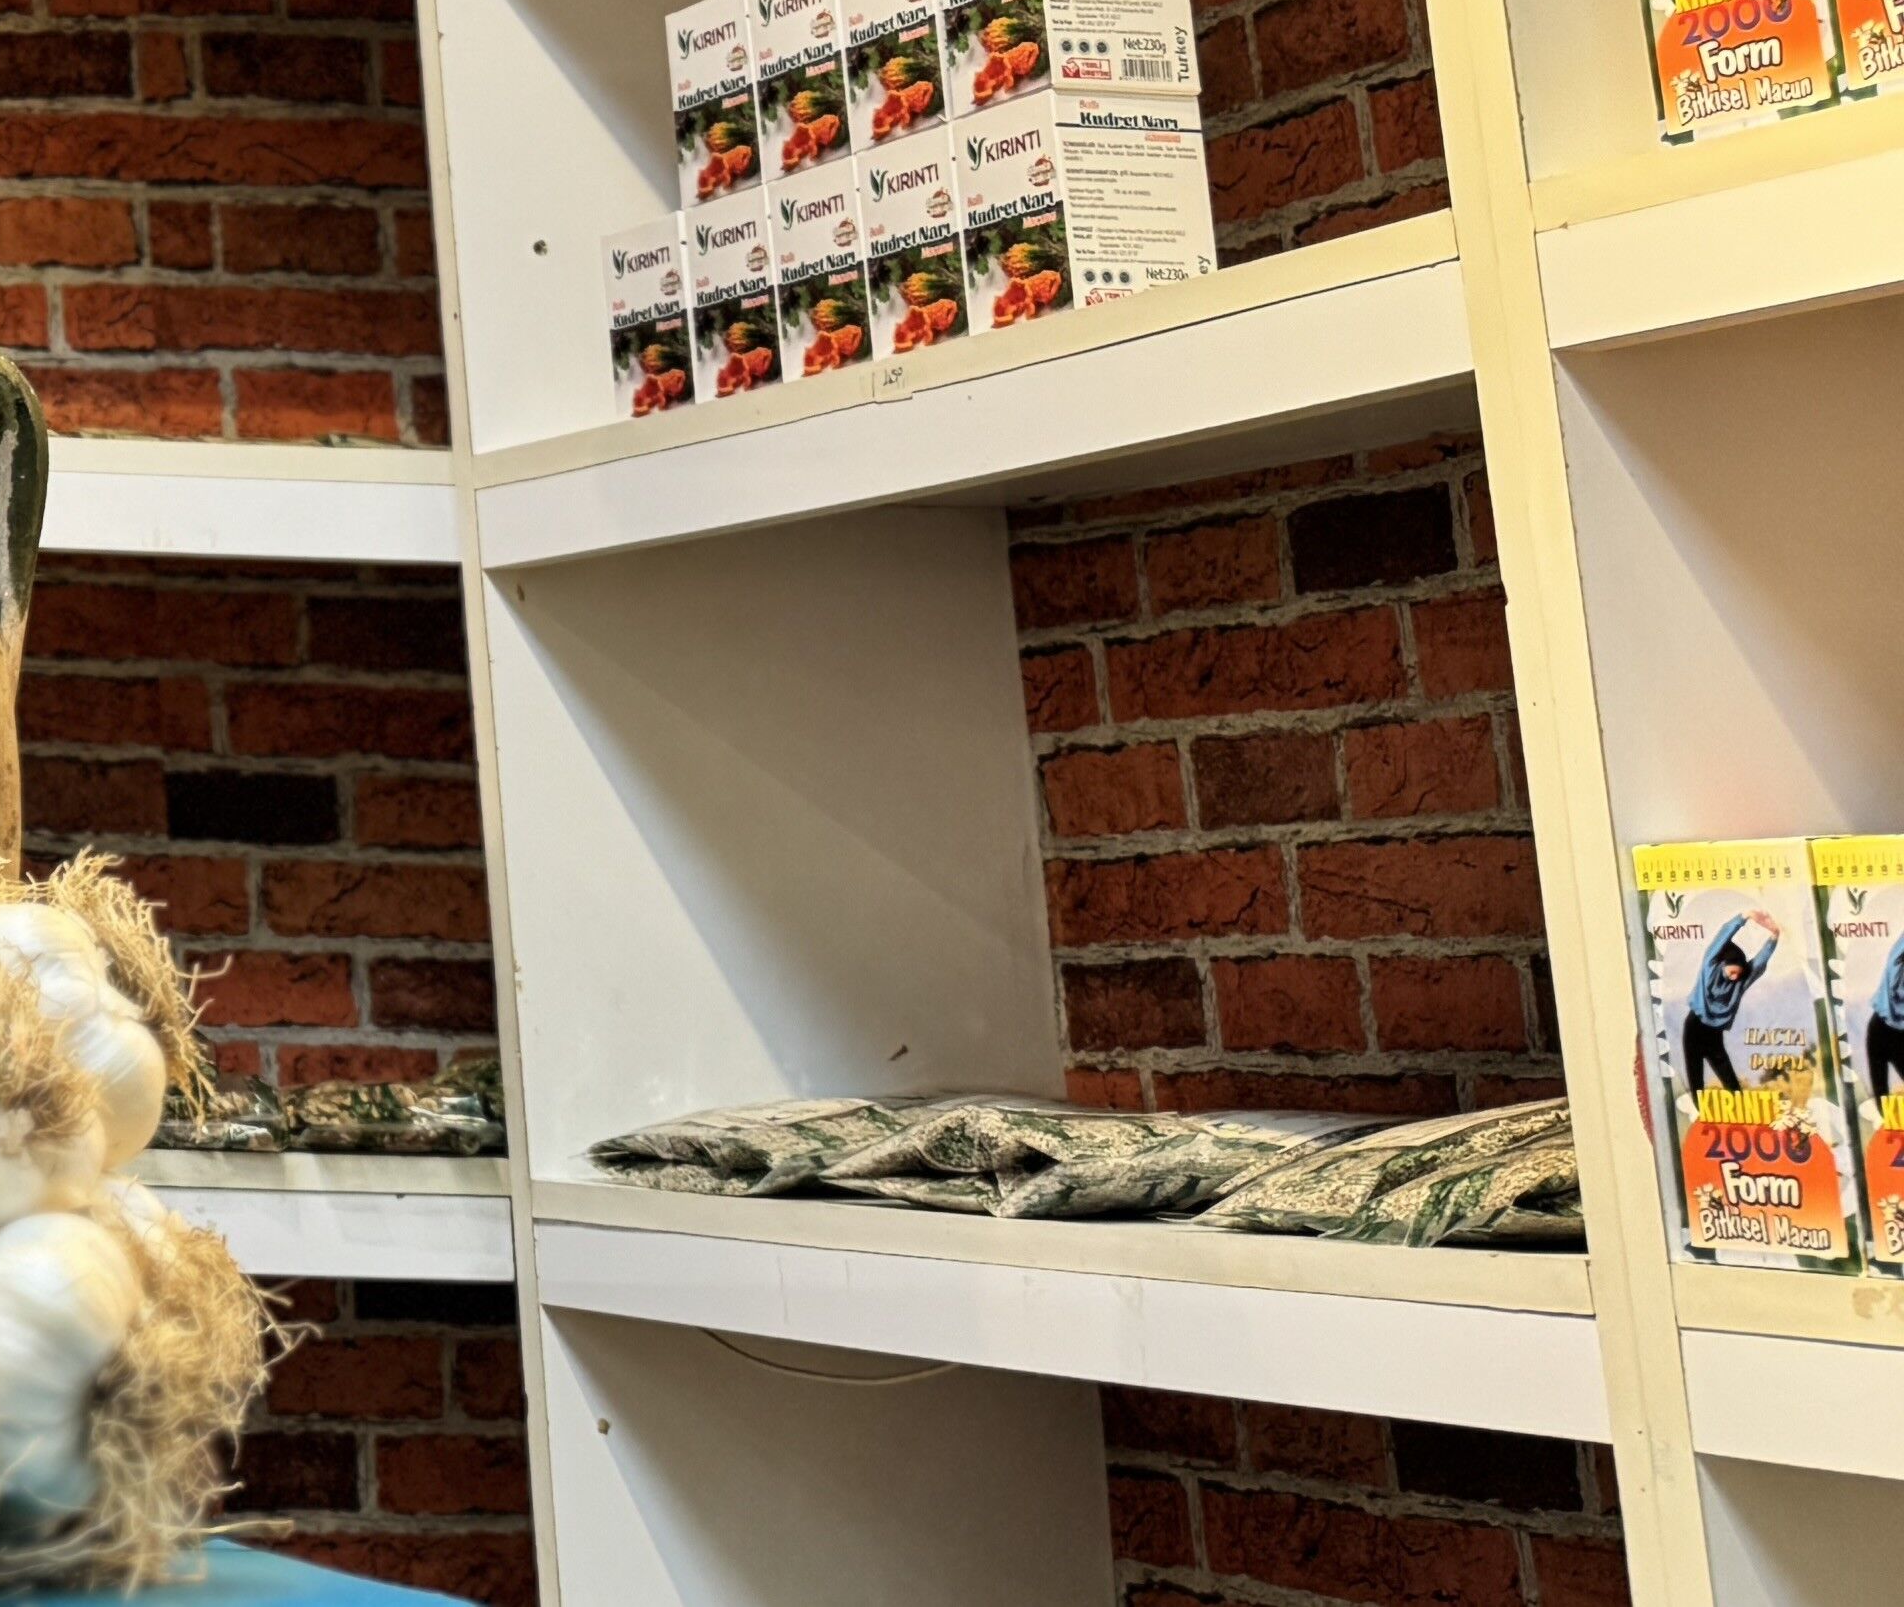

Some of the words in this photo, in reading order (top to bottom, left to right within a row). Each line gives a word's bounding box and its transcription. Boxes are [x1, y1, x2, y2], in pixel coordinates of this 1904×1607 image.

[692, 21, 737, 52] KIRINTI
[850, 17, 894, 45] Kudret
[760, 53, 801, 78] Kudret
[1175, 26, 1188, 83] Turkey
[1698, 36, 1783, 83] Form
[678, 84, 718, 110] Kudret
[1676, 78, 1750, 126] Bitkisel
[1755, 75, 1813, 106] Macun
[1080, 112, 1138, 127] Kudret
[1142, 115, 1178, 130] Narı
[985, 129, 1041, 164] KIRINTI
[886, 163, 939, 195] KIRINTI
[795, 194, 845, 224] KIRINTI
[967, 201, 1018, 227] Kudret
[1020, 191, 1054, 212] Narı
[710, 221, 757, 249] KIRINTI
[870, 231, 916, 257] Kudret
[627, 246, 671, 273] KIRINTI
[781, 258, 824, 283] Kudret
[696, 283, 737, 307] Kudret
[613, 306, 652, 328] Kudret
[1653, 924, 1704, 940] KIRINTI
[1833, 922, 1889, 938] KIRINTI
[1701, 1124, 1812, 1163] 2000
[1720, 1159, 1803, 1209] Form
[1699, 1207, 1769, 1244] Bitkisel
[1774, 1213, 1832, 1250] Macun
